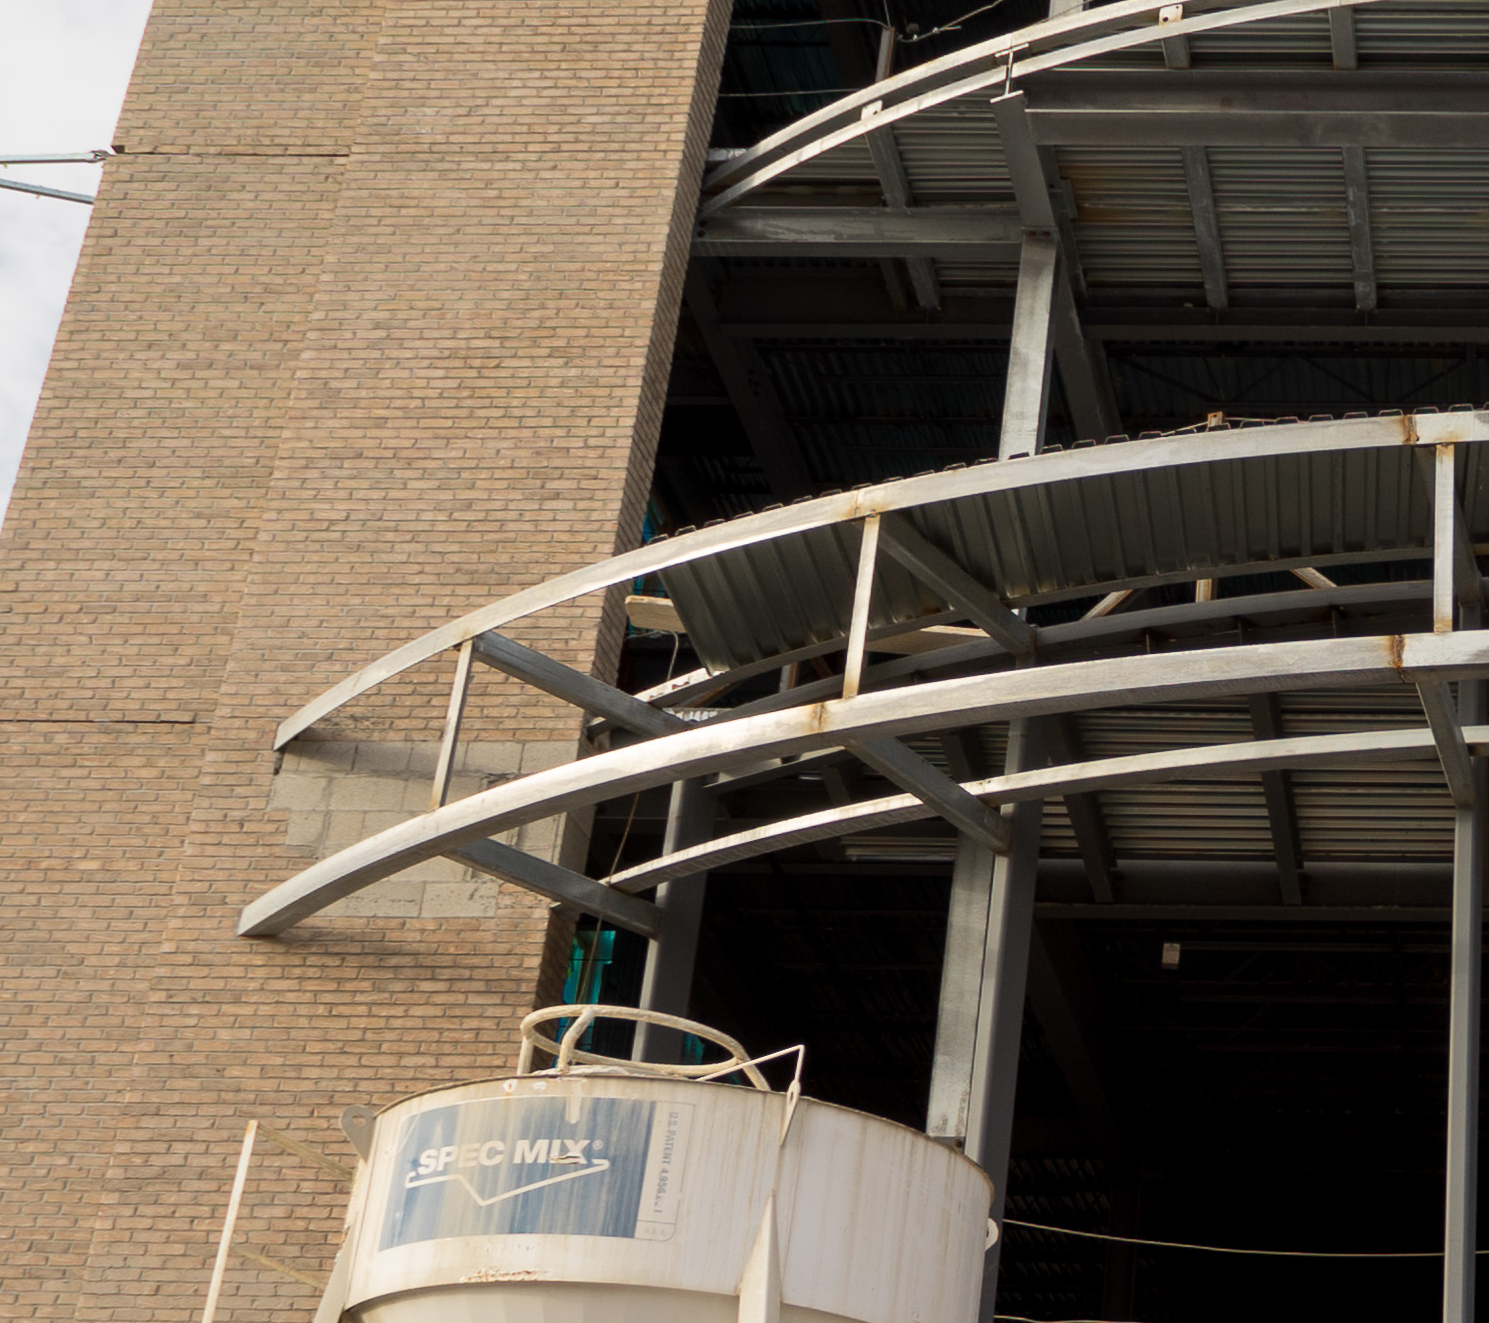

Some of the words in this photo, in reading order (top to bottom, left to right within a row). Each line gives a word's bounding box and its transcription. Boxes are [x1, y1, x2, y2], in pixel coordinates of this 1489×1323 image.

[416, 1140, 506, 1176] SPEC
[513, 1139, 591, 1165] MIX
[661, 1130, 676, 1165] PATENT
